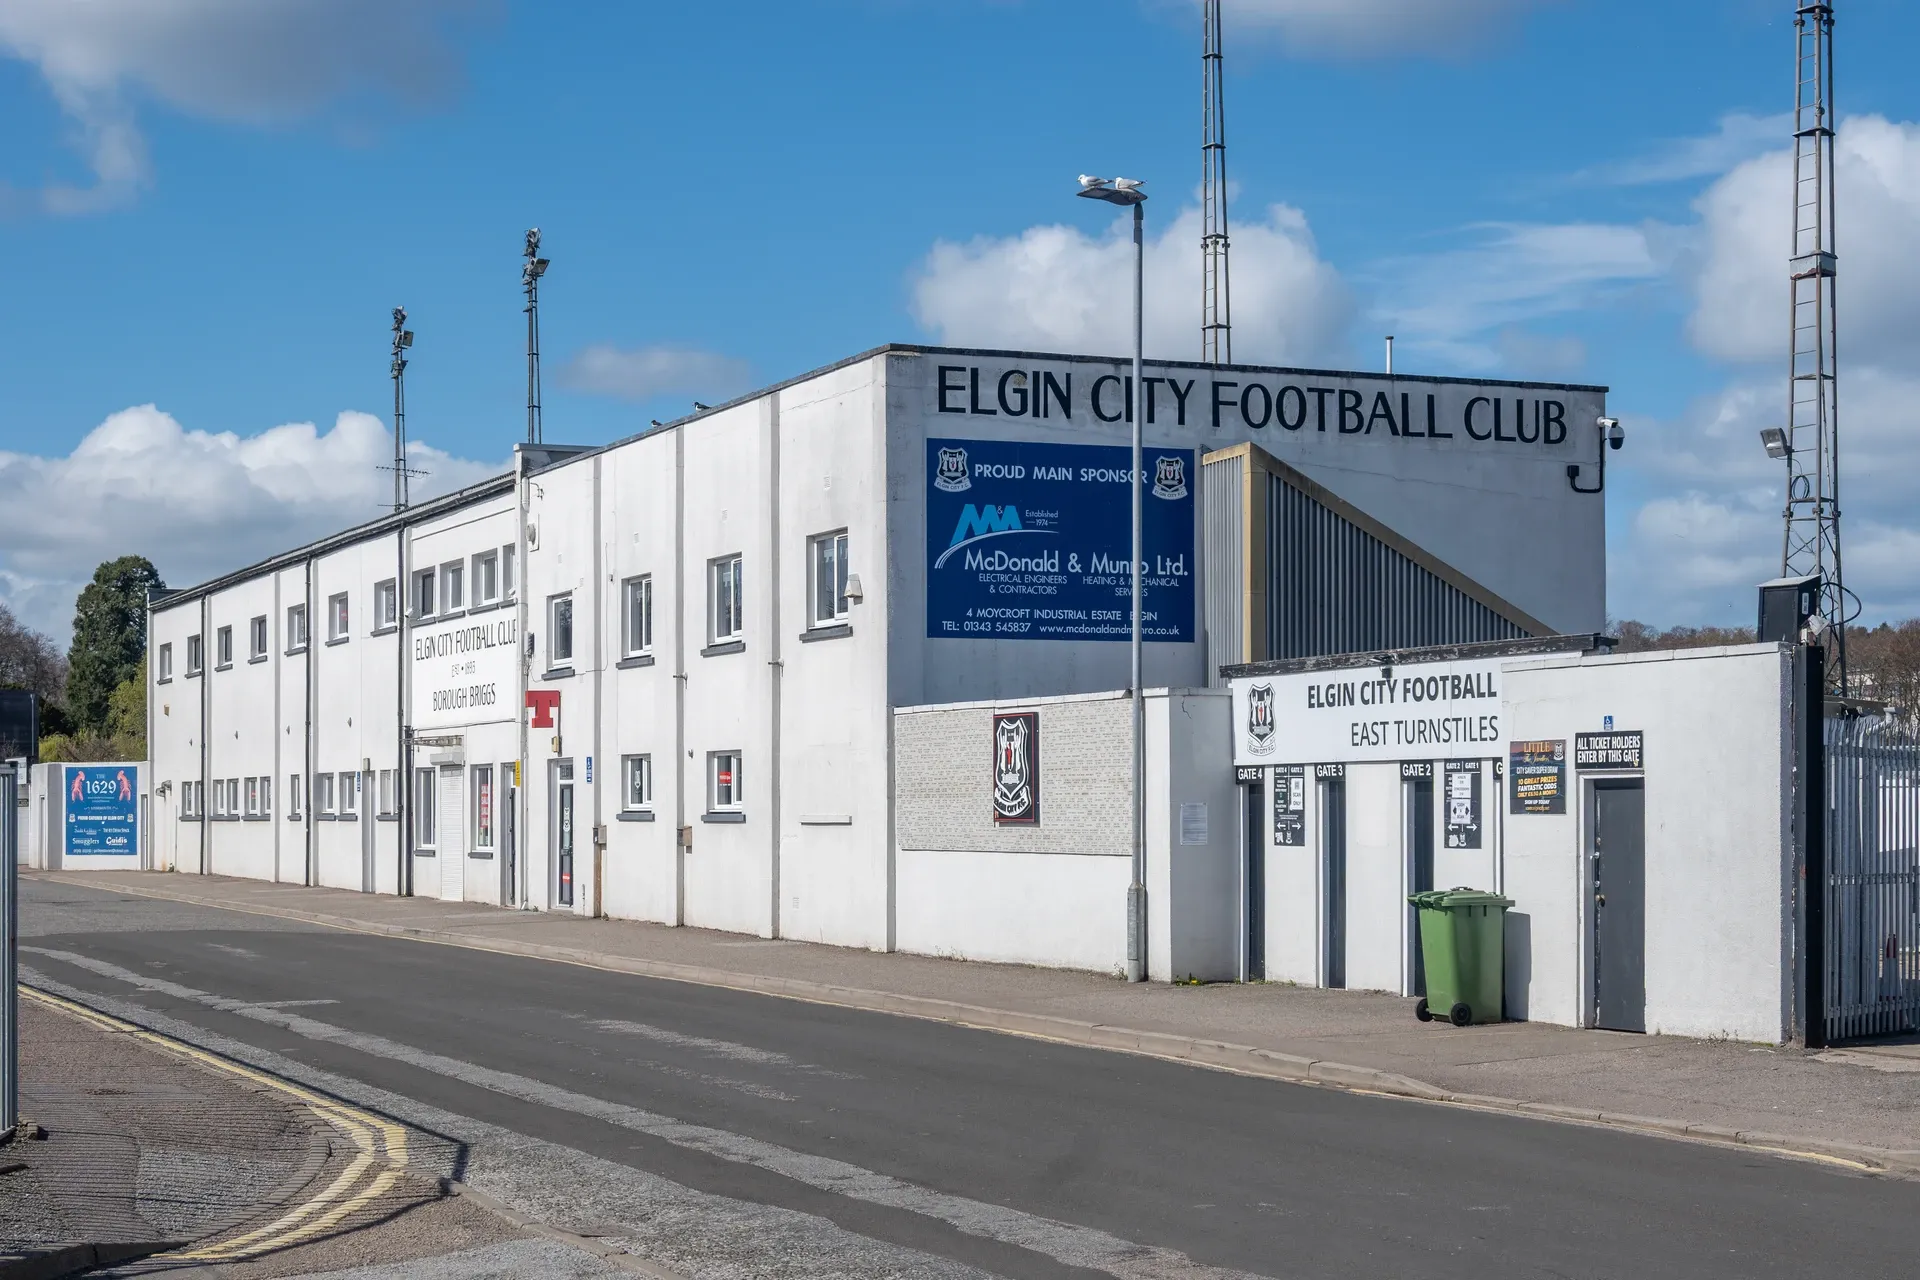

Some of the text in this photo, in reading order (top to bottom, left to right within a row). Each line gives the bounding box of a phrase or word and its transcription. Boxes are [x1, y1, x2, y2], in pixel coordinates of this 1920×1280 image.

[938, 365, 1567, 445] ELGIN CITY FOOTBALL CLUB
[975, 464, 1025, 479] PROUD
[1033, 466, 1072, 481] MAIN
[1025, 509, 1059, 519] Established
[965, 548, 1059, 573] McDonald
[1068, 553, 1082, 573] &
[1157, 554, 1188, 576] Ltd.
[978, 573, 1068, 584] ELECTRICAL ENGINEERS
[1082, 576, 1179, 587] HEATING & MCHANICAL
[989, 585, 1057, 595] & CONTRACTORS
[966, 607, 1157, 621] 4 MOYCROFT INDUSTRIAL ESTATE EGIN
[942, 621, 1180, 635] TEL: 01343 545837 www.mcdonaldandmnro.co.uk
[415, 635, 436, 661] ELGIN
[437, 632, 454, 657] CITY
[455, 623, 496, 654] FOOTBALL
[433, 682, 496, 712] BOROUGH BRIGGS
[1307, 672, 1498, 709] ELGIN CITY FOOTBALL
[1351, 715, 1499, 747] EAST TURNSTILES
[1524, 742, 1550, 752] LITTLE
[1577, 735, 1640, 750] ALL TICKET HOLDERS
[1577, 749, 1640, 763] ENTER BY THIS GATE
[1238, 768, 1263, 780] GATE 4
[1316, 764, 1343, 777] GATE 3
[1402, 764, 1432, 776] GATE 2
[86, 780, 117, 794] 1629
[1517, 784, 1543, 792] FANTASTIC
[1524, 777, 1540, 785] GREAT
